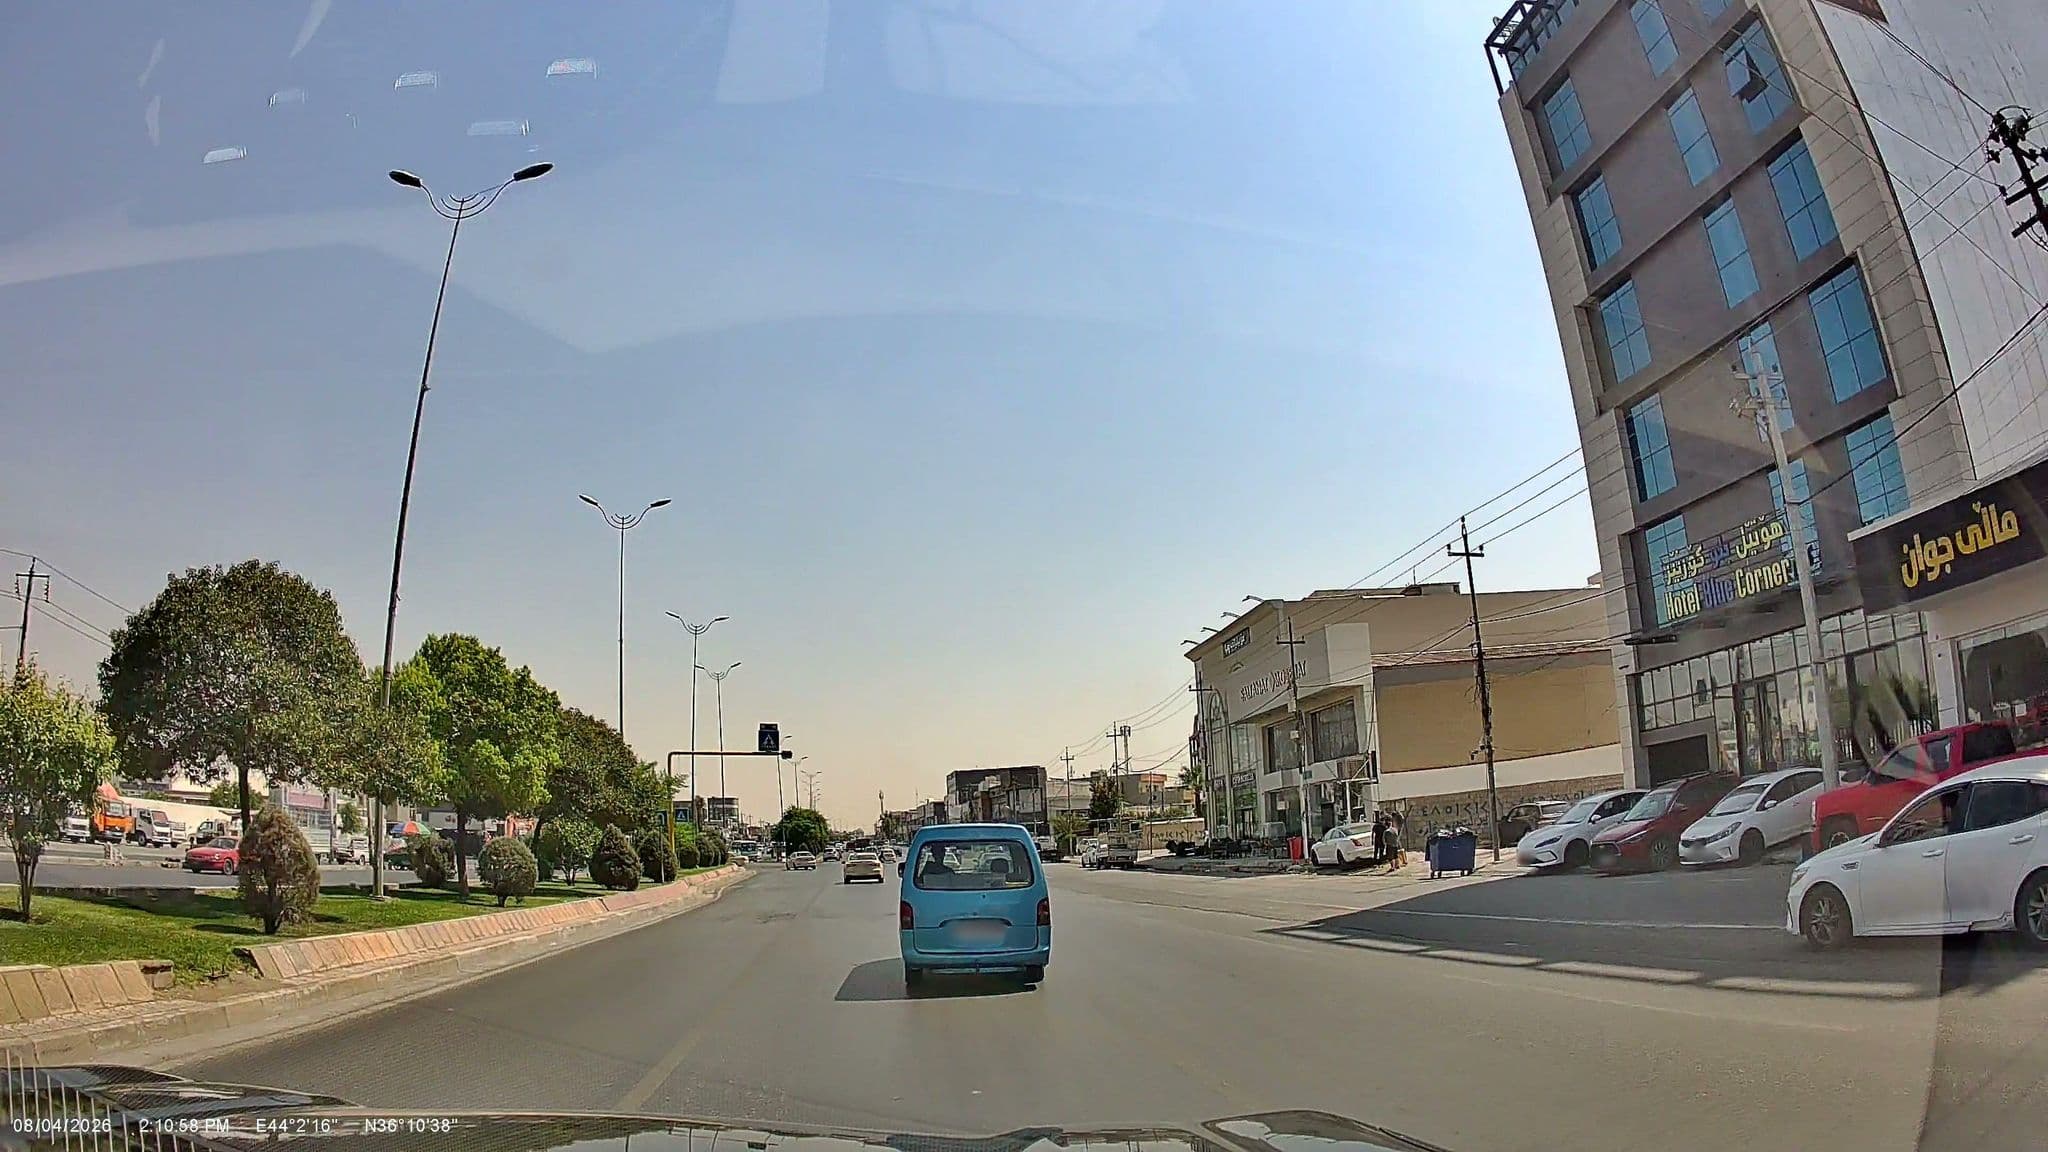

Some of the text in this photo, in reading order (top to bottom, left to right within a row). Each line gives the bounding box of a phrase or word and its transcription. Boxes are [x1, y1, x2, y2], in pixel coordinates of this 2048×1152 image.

[1664, 583, 1700, 621] Hotel
[1703, 578, 1736, 609] Blue
[1735, 558, 1791, 599] Corner
[1901, 533, 1955, 588] جوان
